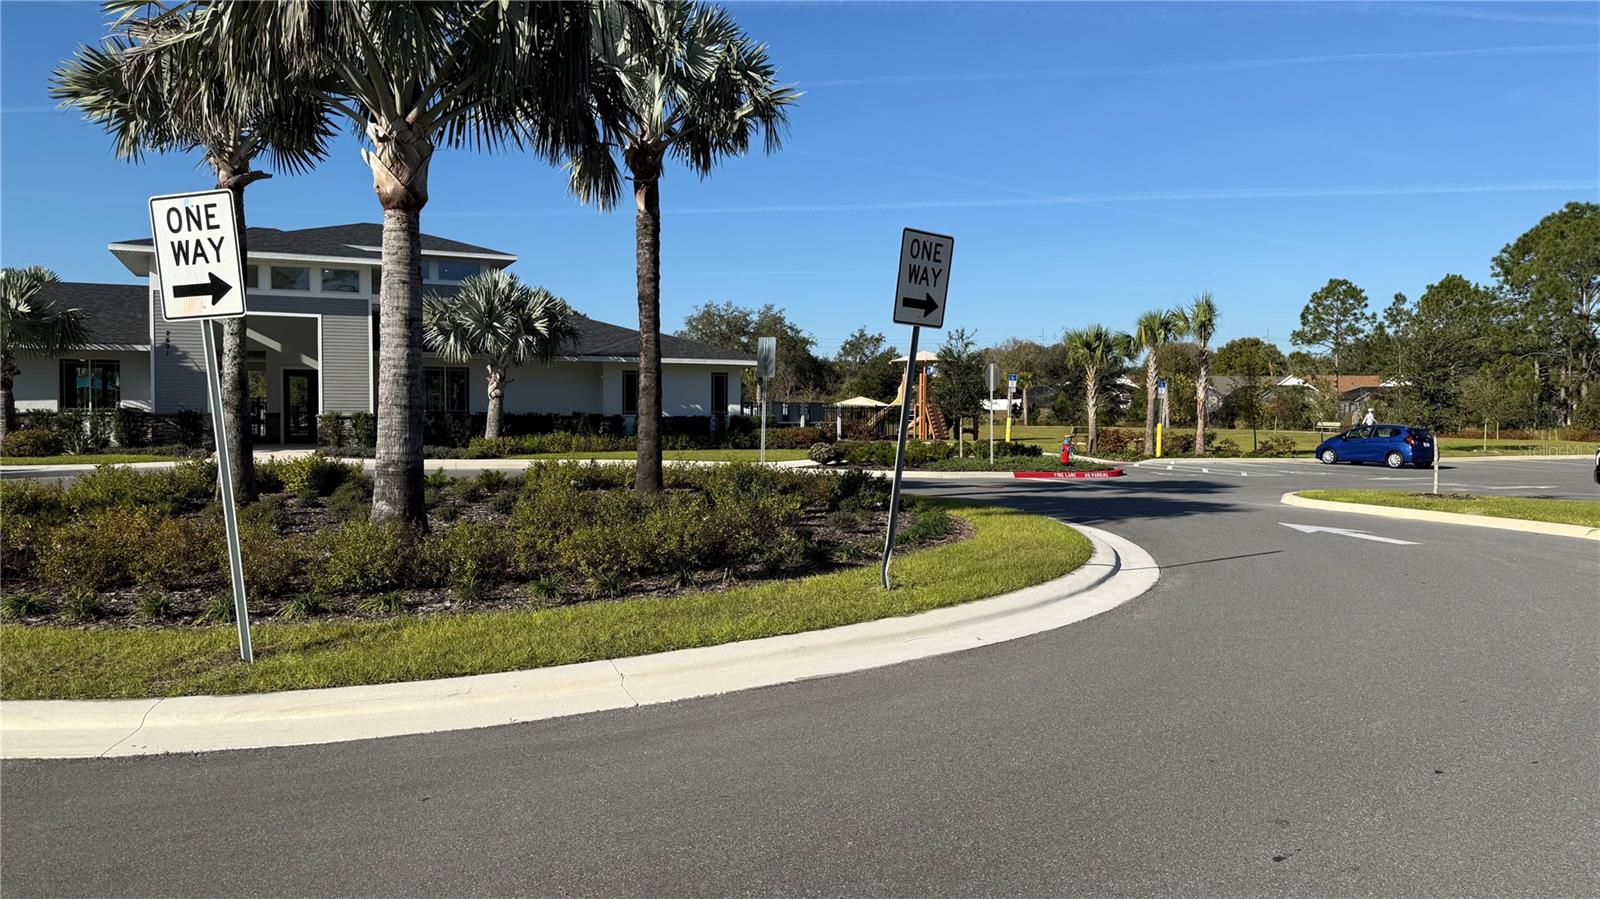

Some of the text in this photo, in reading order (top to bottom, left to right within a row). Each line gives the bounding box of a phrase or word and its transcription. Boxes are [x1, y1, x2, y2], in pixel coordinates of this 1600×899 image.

[167, 203, 221, 234] ONE
[170, 236, 225, 267] WAY
[910, 238, 943, 263] ONE
[908, 264, 943, 288] WAY
